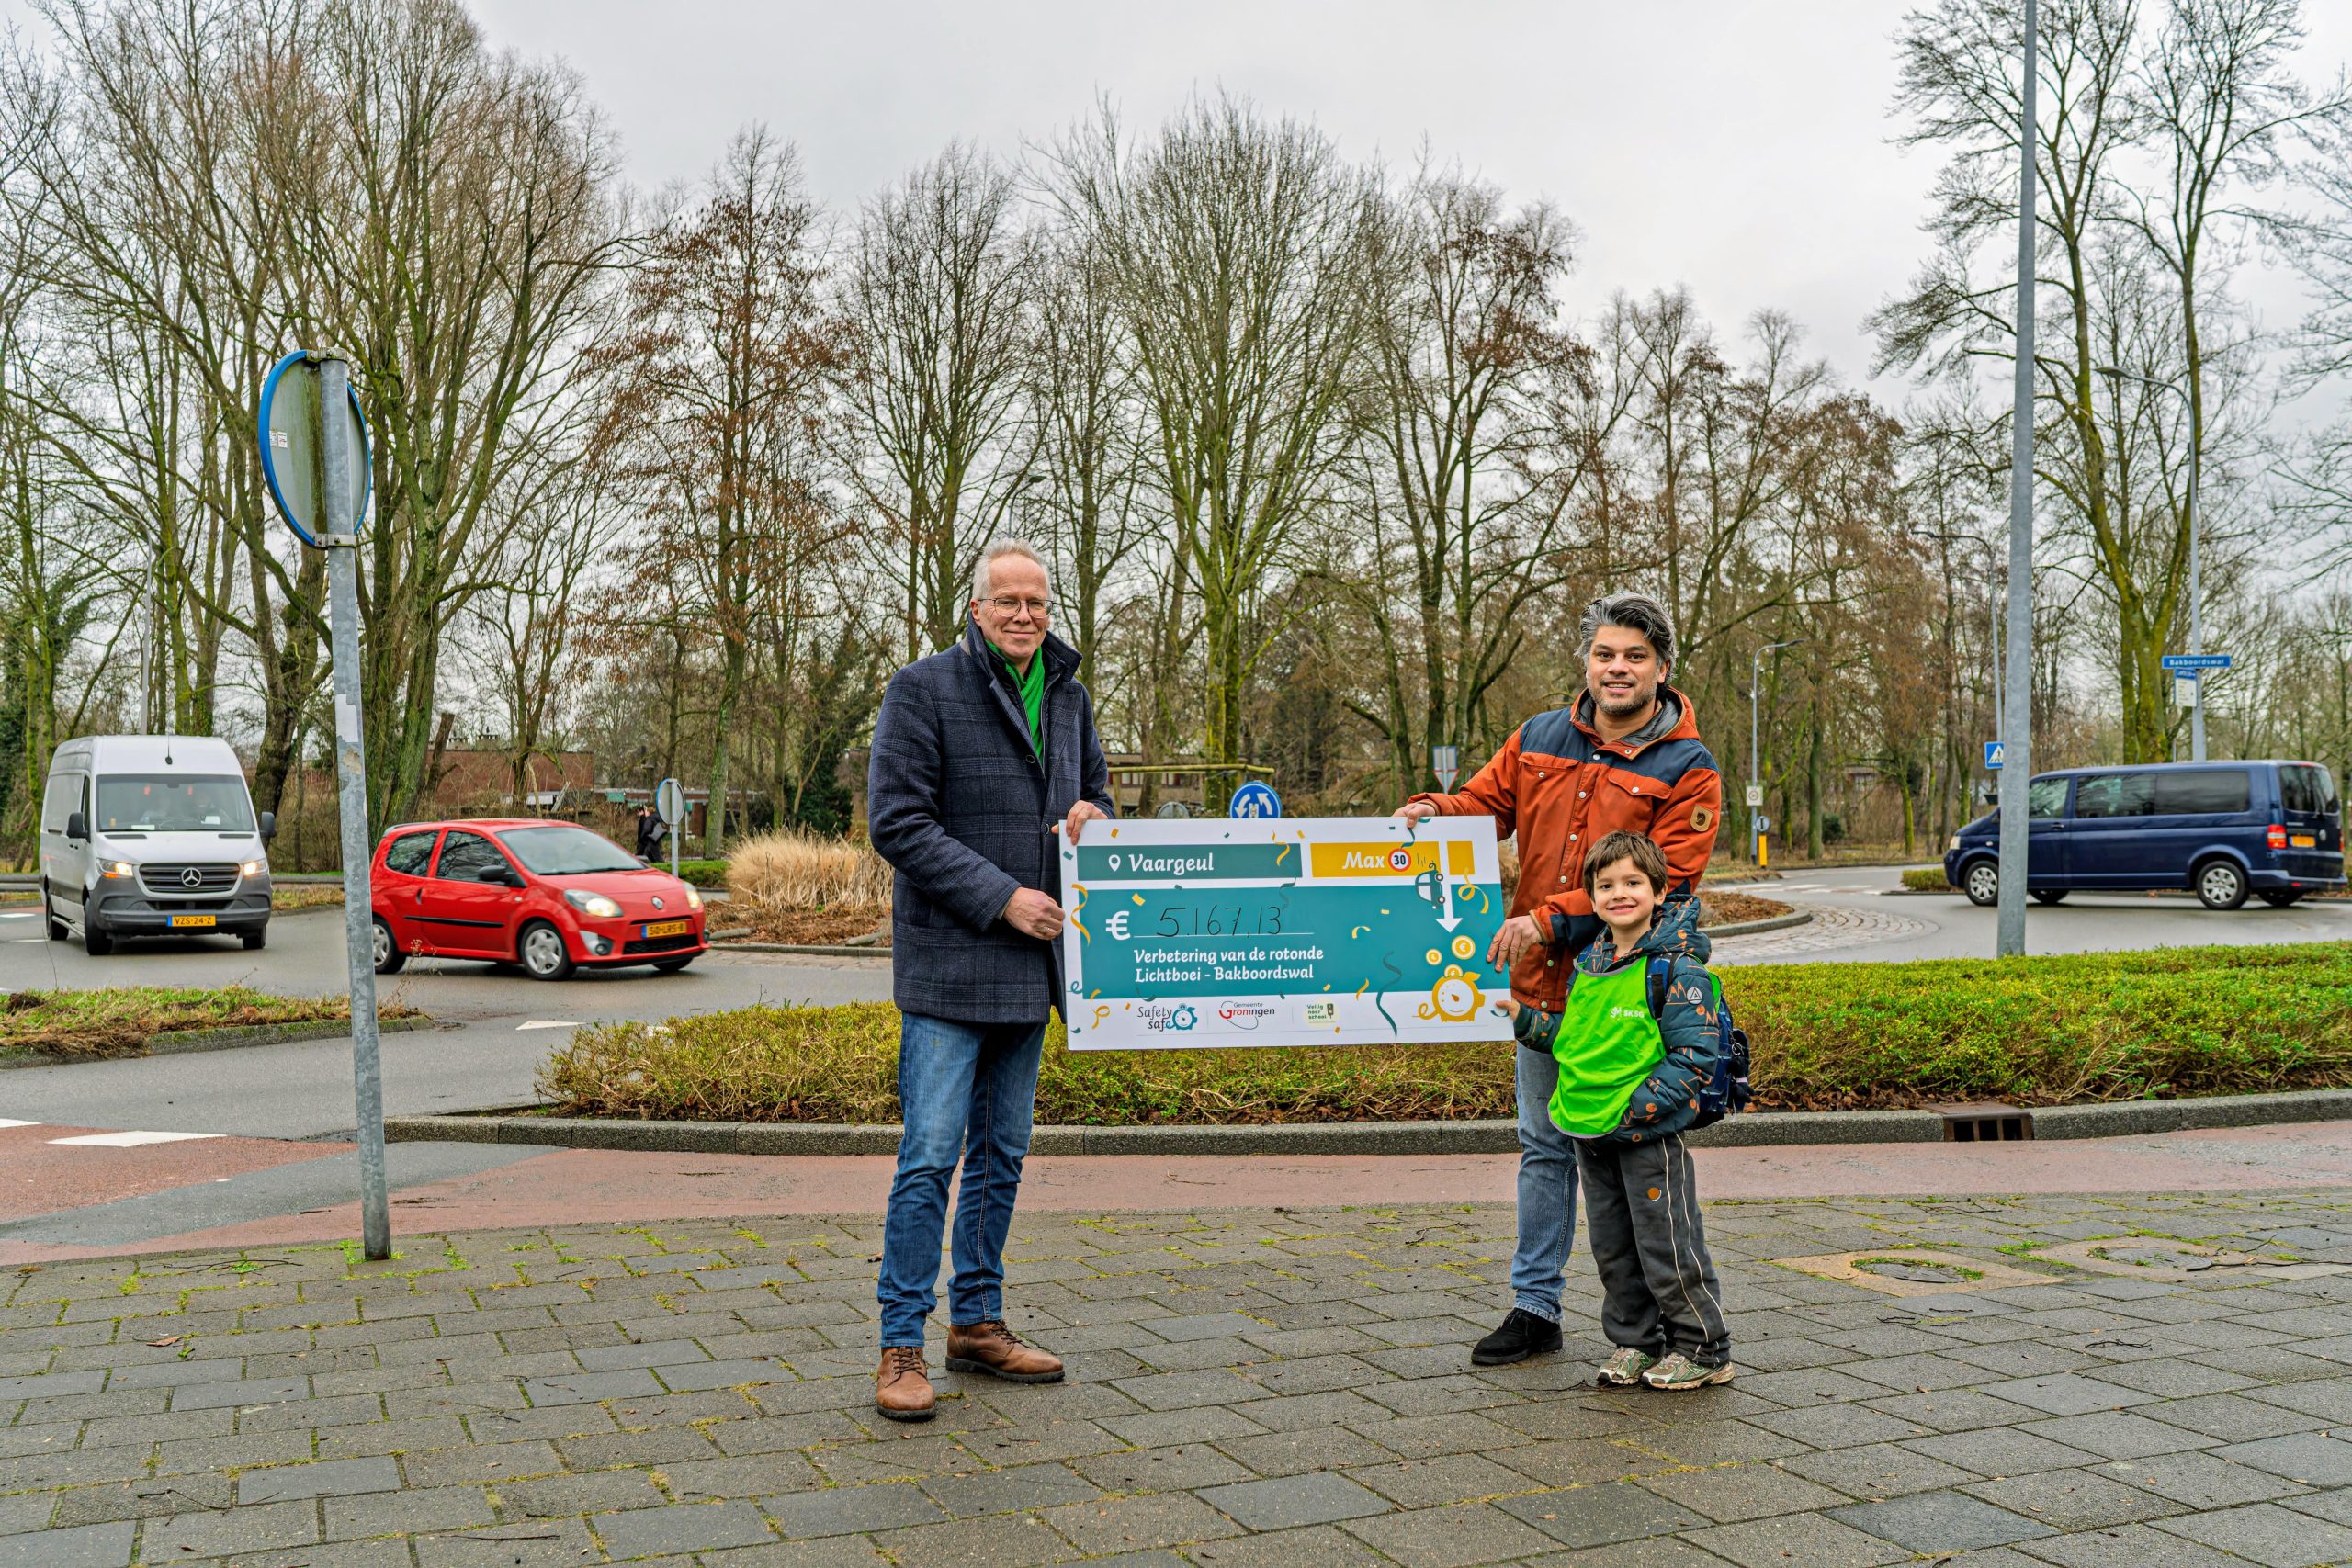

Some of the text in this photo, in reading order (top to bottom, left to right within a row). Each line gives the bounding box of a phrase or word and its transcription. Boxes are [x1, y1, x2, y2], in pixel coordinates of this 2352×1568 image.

[1128, 852, 1215, 876] Vaargeul
[1342, 852, 1407, 870] Max 30
[175, 917, 212, 925] VZS-24-Z
[1105, 904, 1281, 941] € 5.167,13
[1133, 945, 1324, 965] Verbetering van de rotonde
[1135, 967, 1202, 983] Lichtboei
[1213, 964, 1314, 981] Bakboordswal
[1137, 1006, 1173, 1021] Safety
[1219, 1007, 1274, 1020] Groningen
[1148, 1018, 1174, 1032] safe
